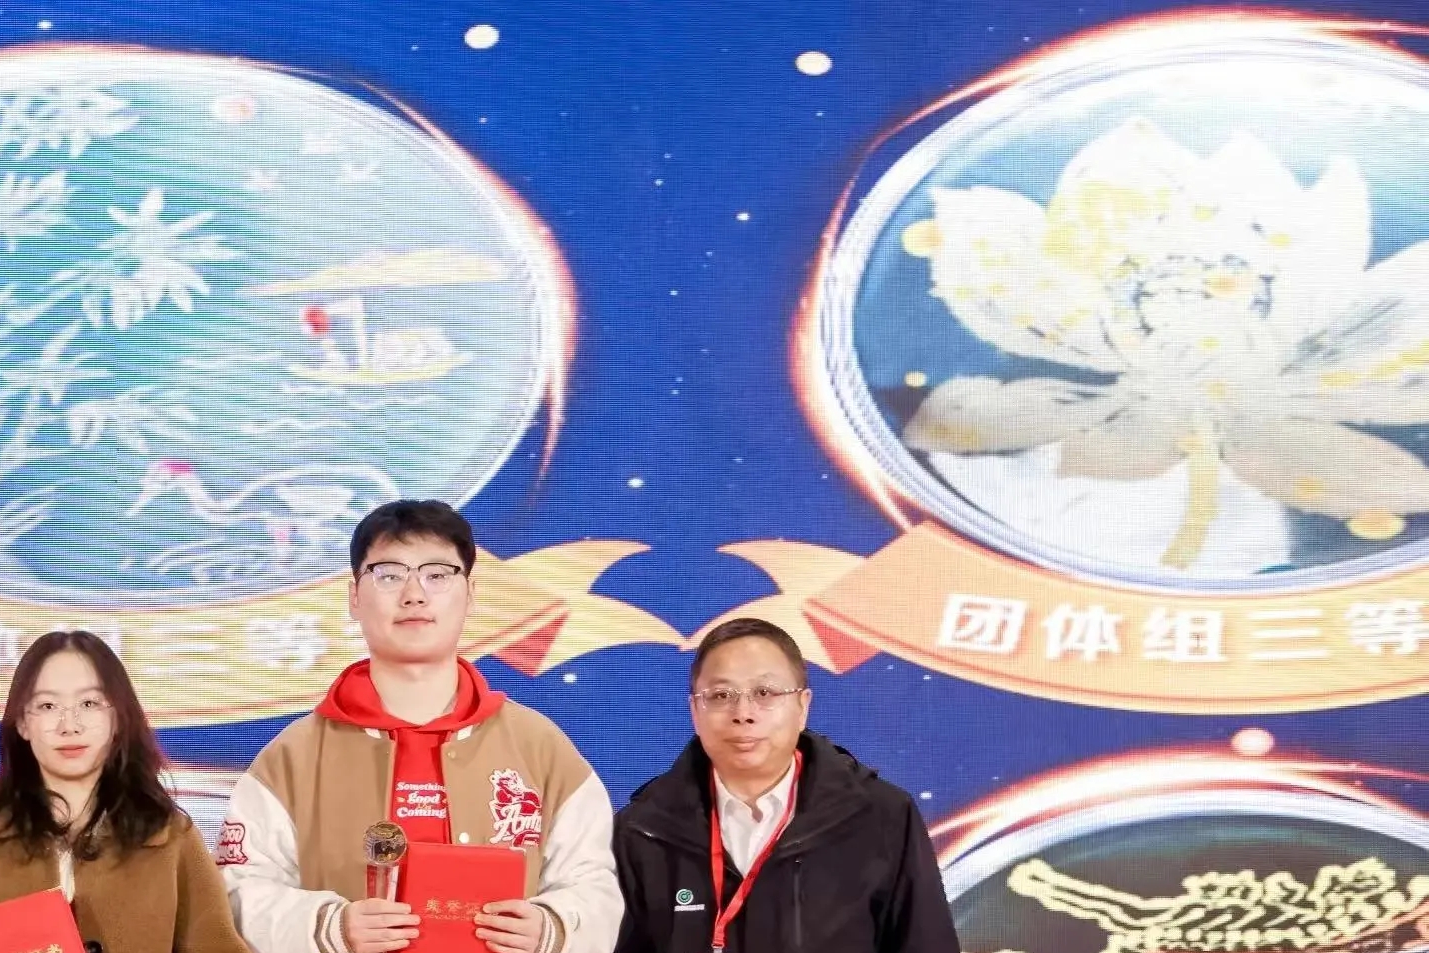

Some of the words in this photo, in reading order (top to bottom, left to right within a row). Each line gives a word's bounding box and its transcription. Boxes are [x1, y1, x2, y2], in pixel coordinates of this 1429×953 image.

[936, 593, 1429, 663] 团体组三等
